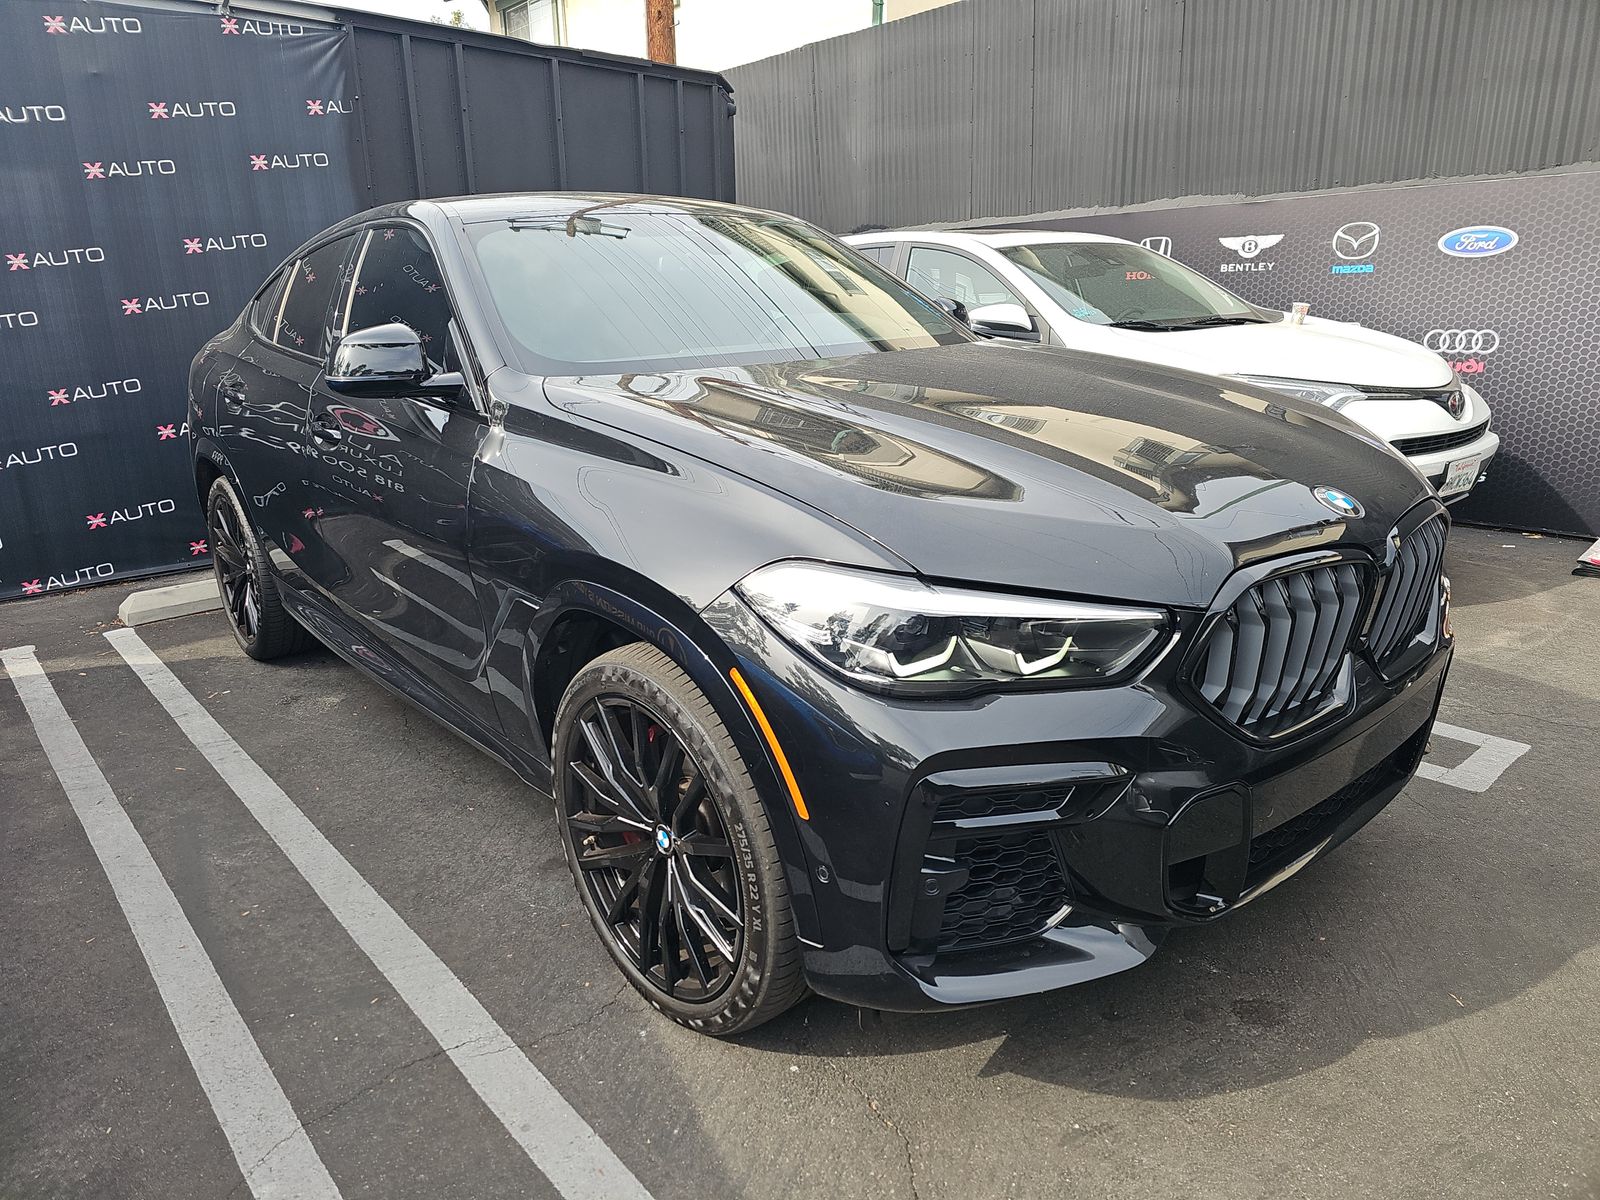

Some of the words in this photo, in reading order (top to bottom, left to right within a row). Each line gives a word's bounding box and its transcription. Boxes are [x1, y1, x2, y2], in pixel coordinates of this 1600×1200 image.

[1455, 232, 1497, 251] Ford
[1220, 261, 1276, 273] BENTLEY
[1332, 264, 1375, 275] mazda
[6, 442, 78, 468] AUTO
[734, 822, 755, 869] 275/35
